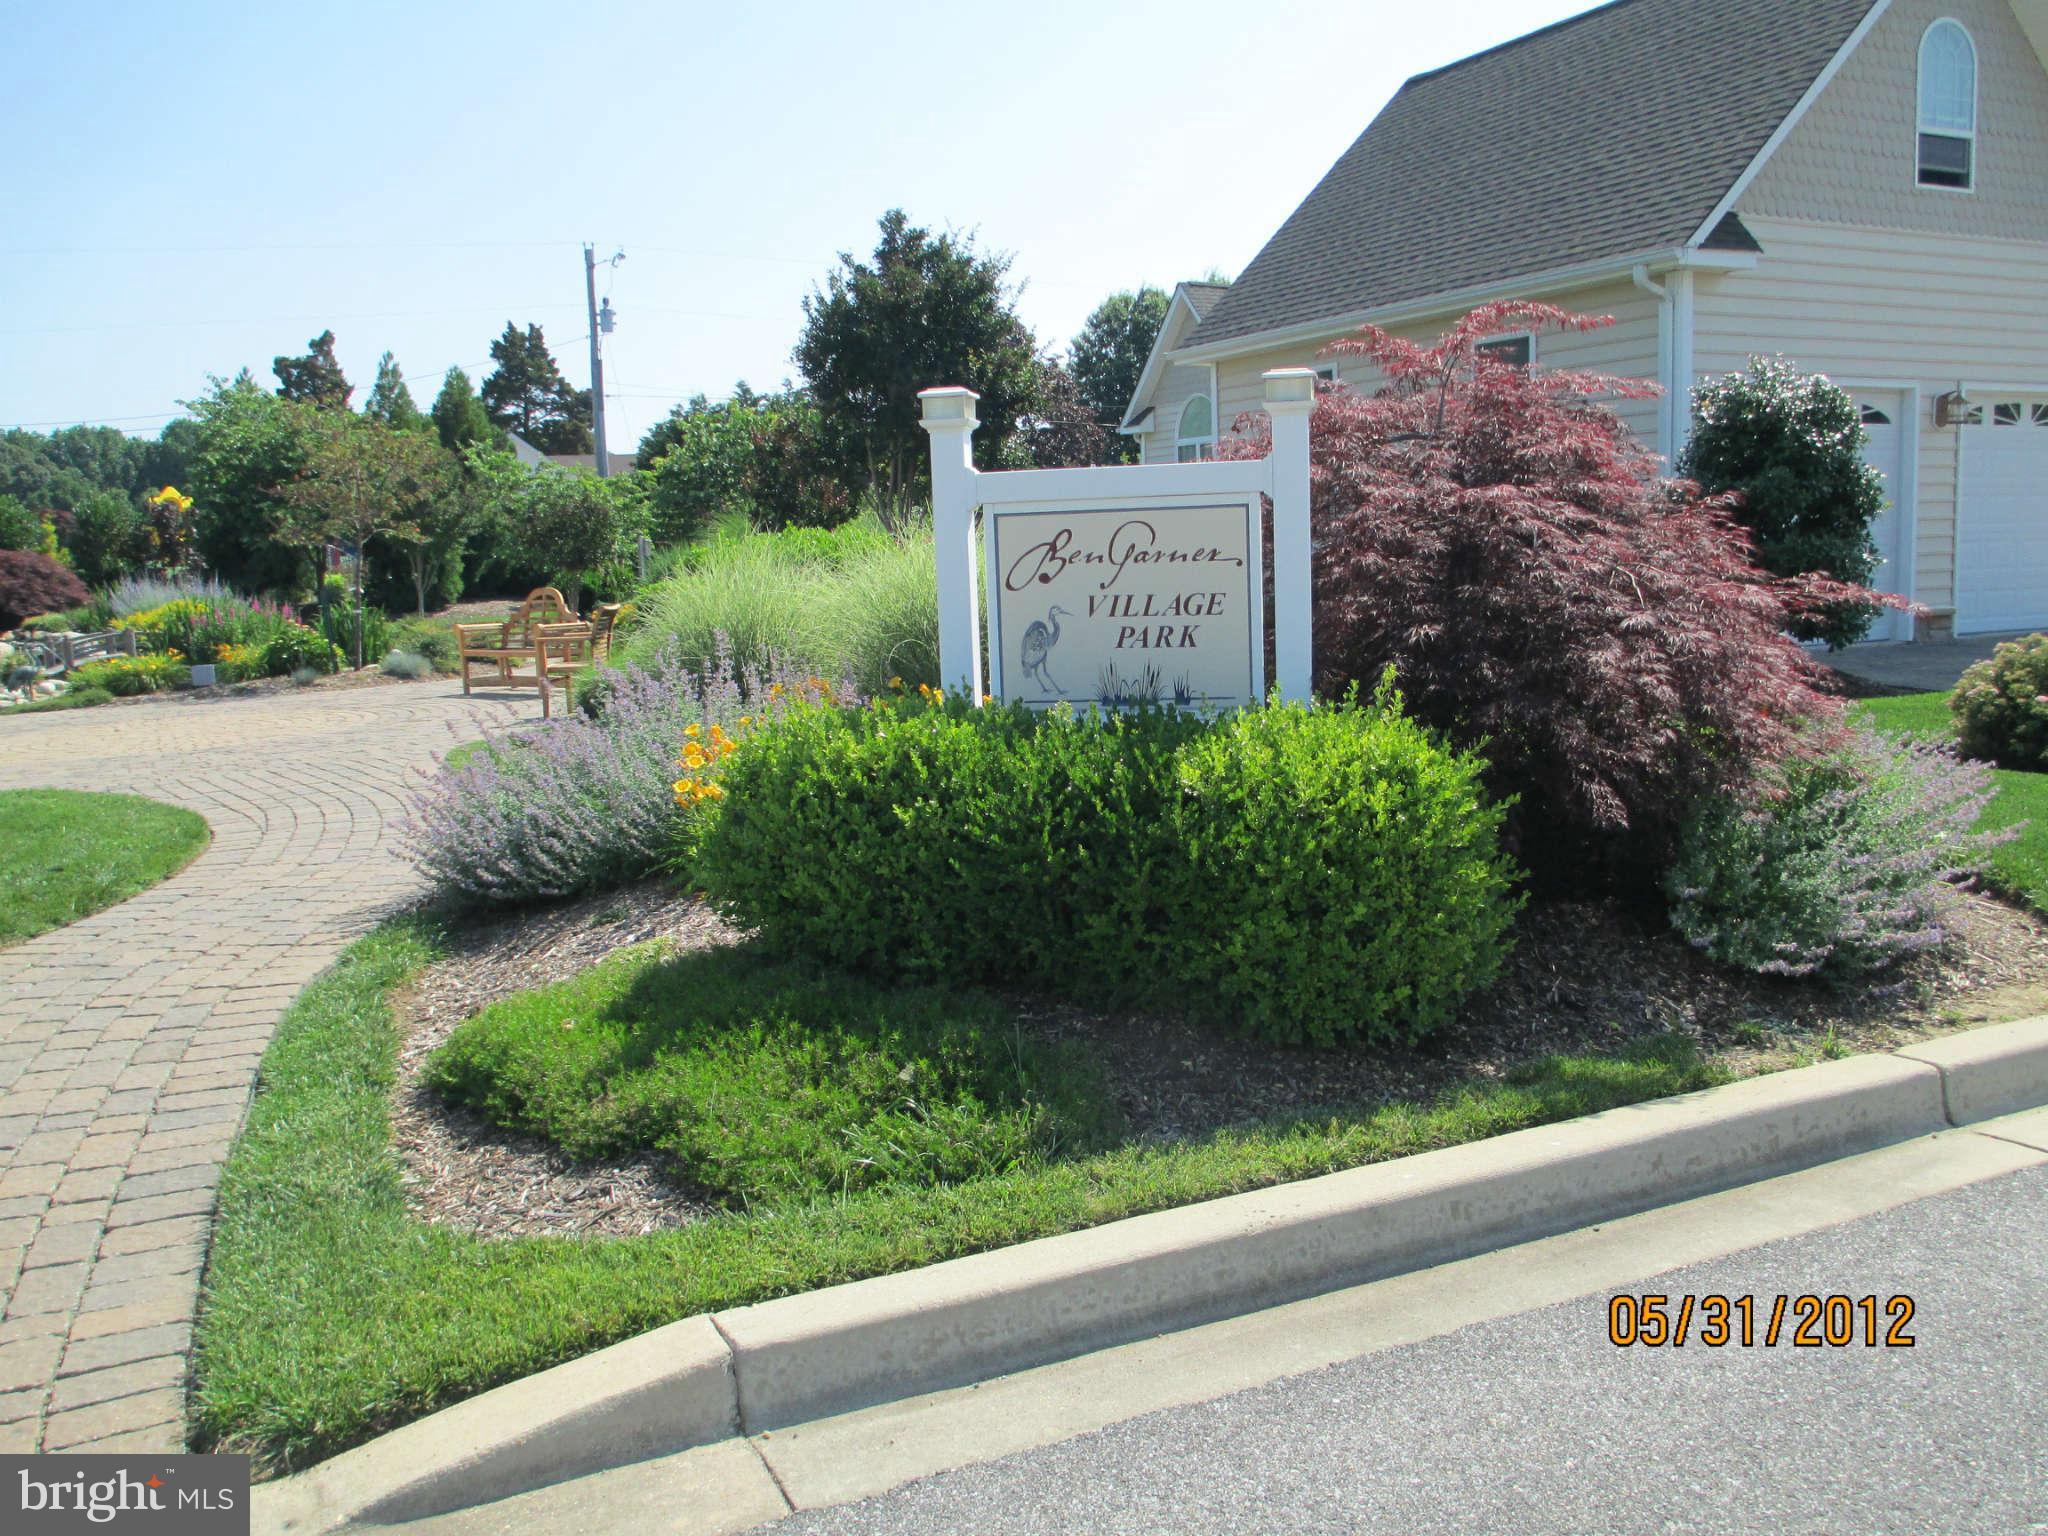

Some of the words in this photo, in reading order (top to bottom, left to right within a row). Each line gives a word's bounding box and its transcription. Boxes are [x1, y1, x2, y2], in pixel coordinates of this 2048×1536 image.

[1005, 528, 1104, 591] Ben
[1099, 520, 1243, 589] Garner
[1088, 592, 1226, 618] VILLAGE
[1115, 624, 1201, 649] PARK
